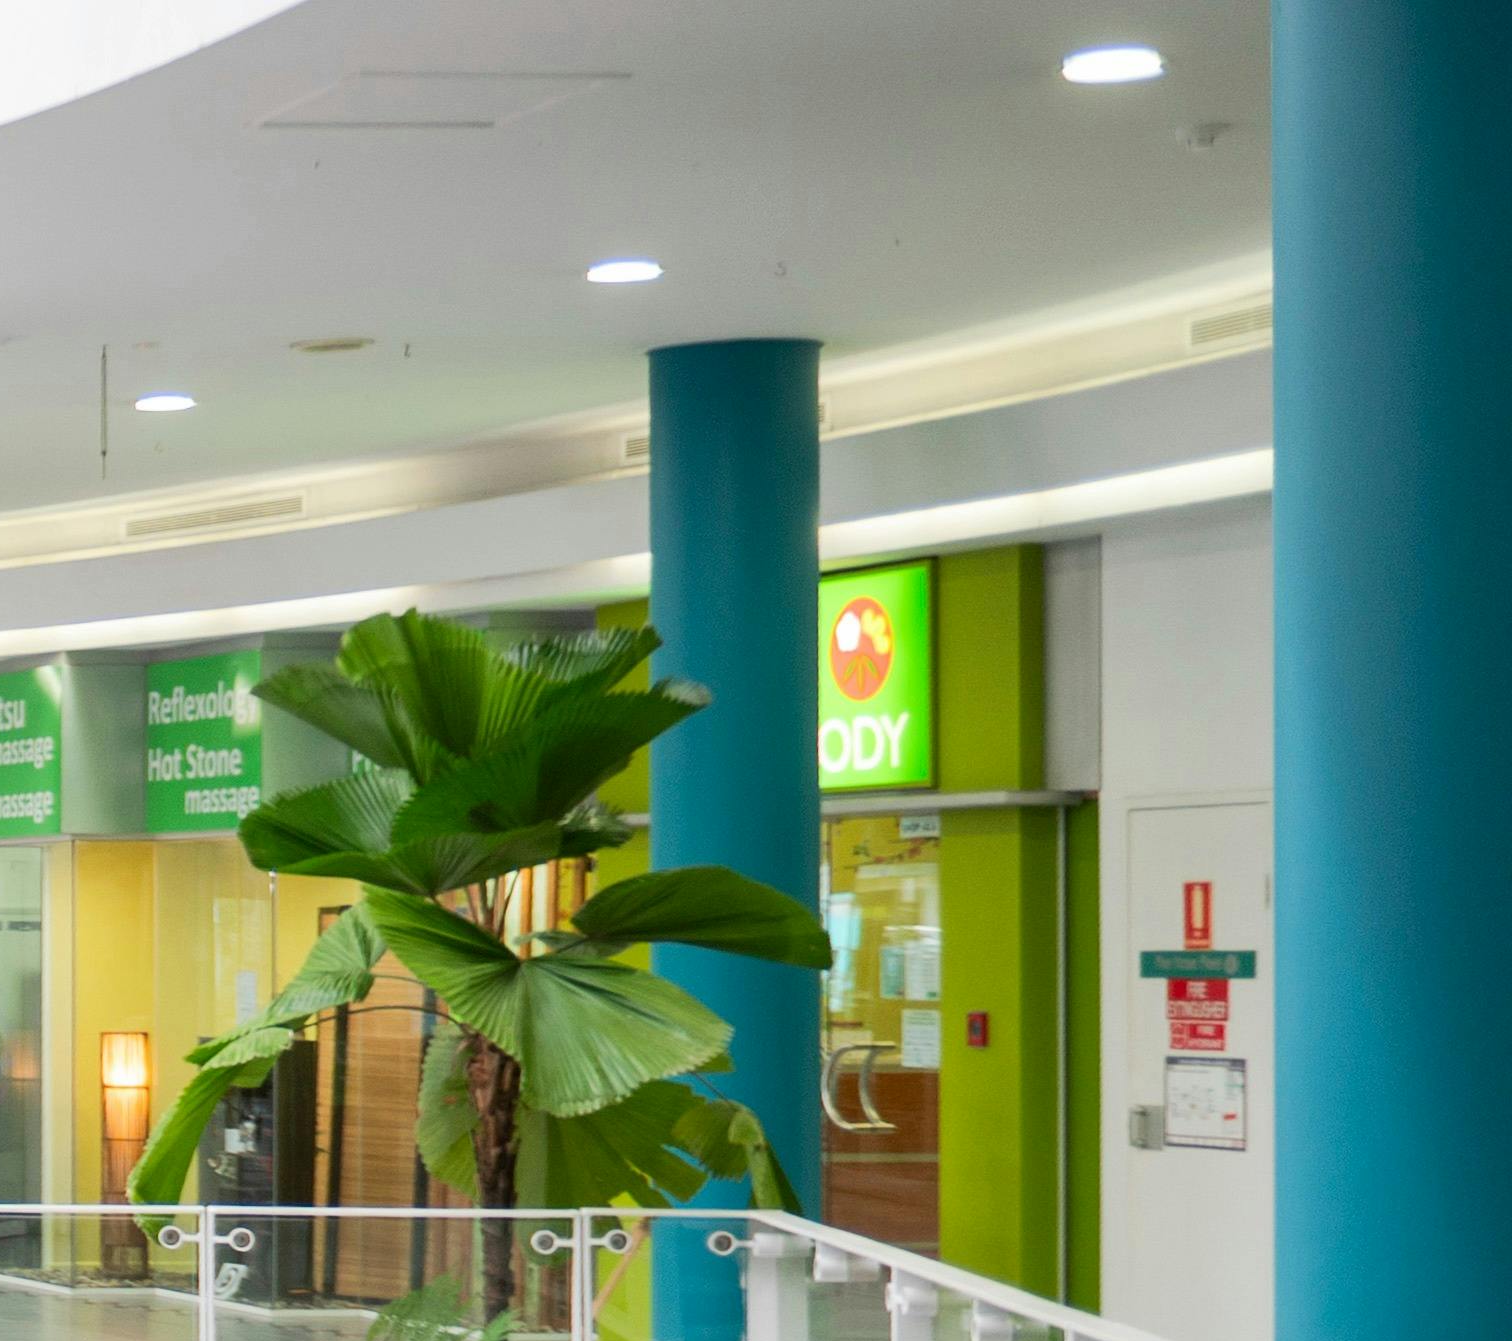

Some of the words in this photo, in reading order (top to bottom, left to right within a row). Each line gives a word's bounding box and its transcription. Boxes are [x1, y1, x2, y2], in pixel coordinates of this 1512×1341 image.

[148, 680, 259, 726] Reflexology
[148, 748, 182, 782] Hot
[186, 744, 242, 778] Stone
[184, 784, 261, 820] massage
